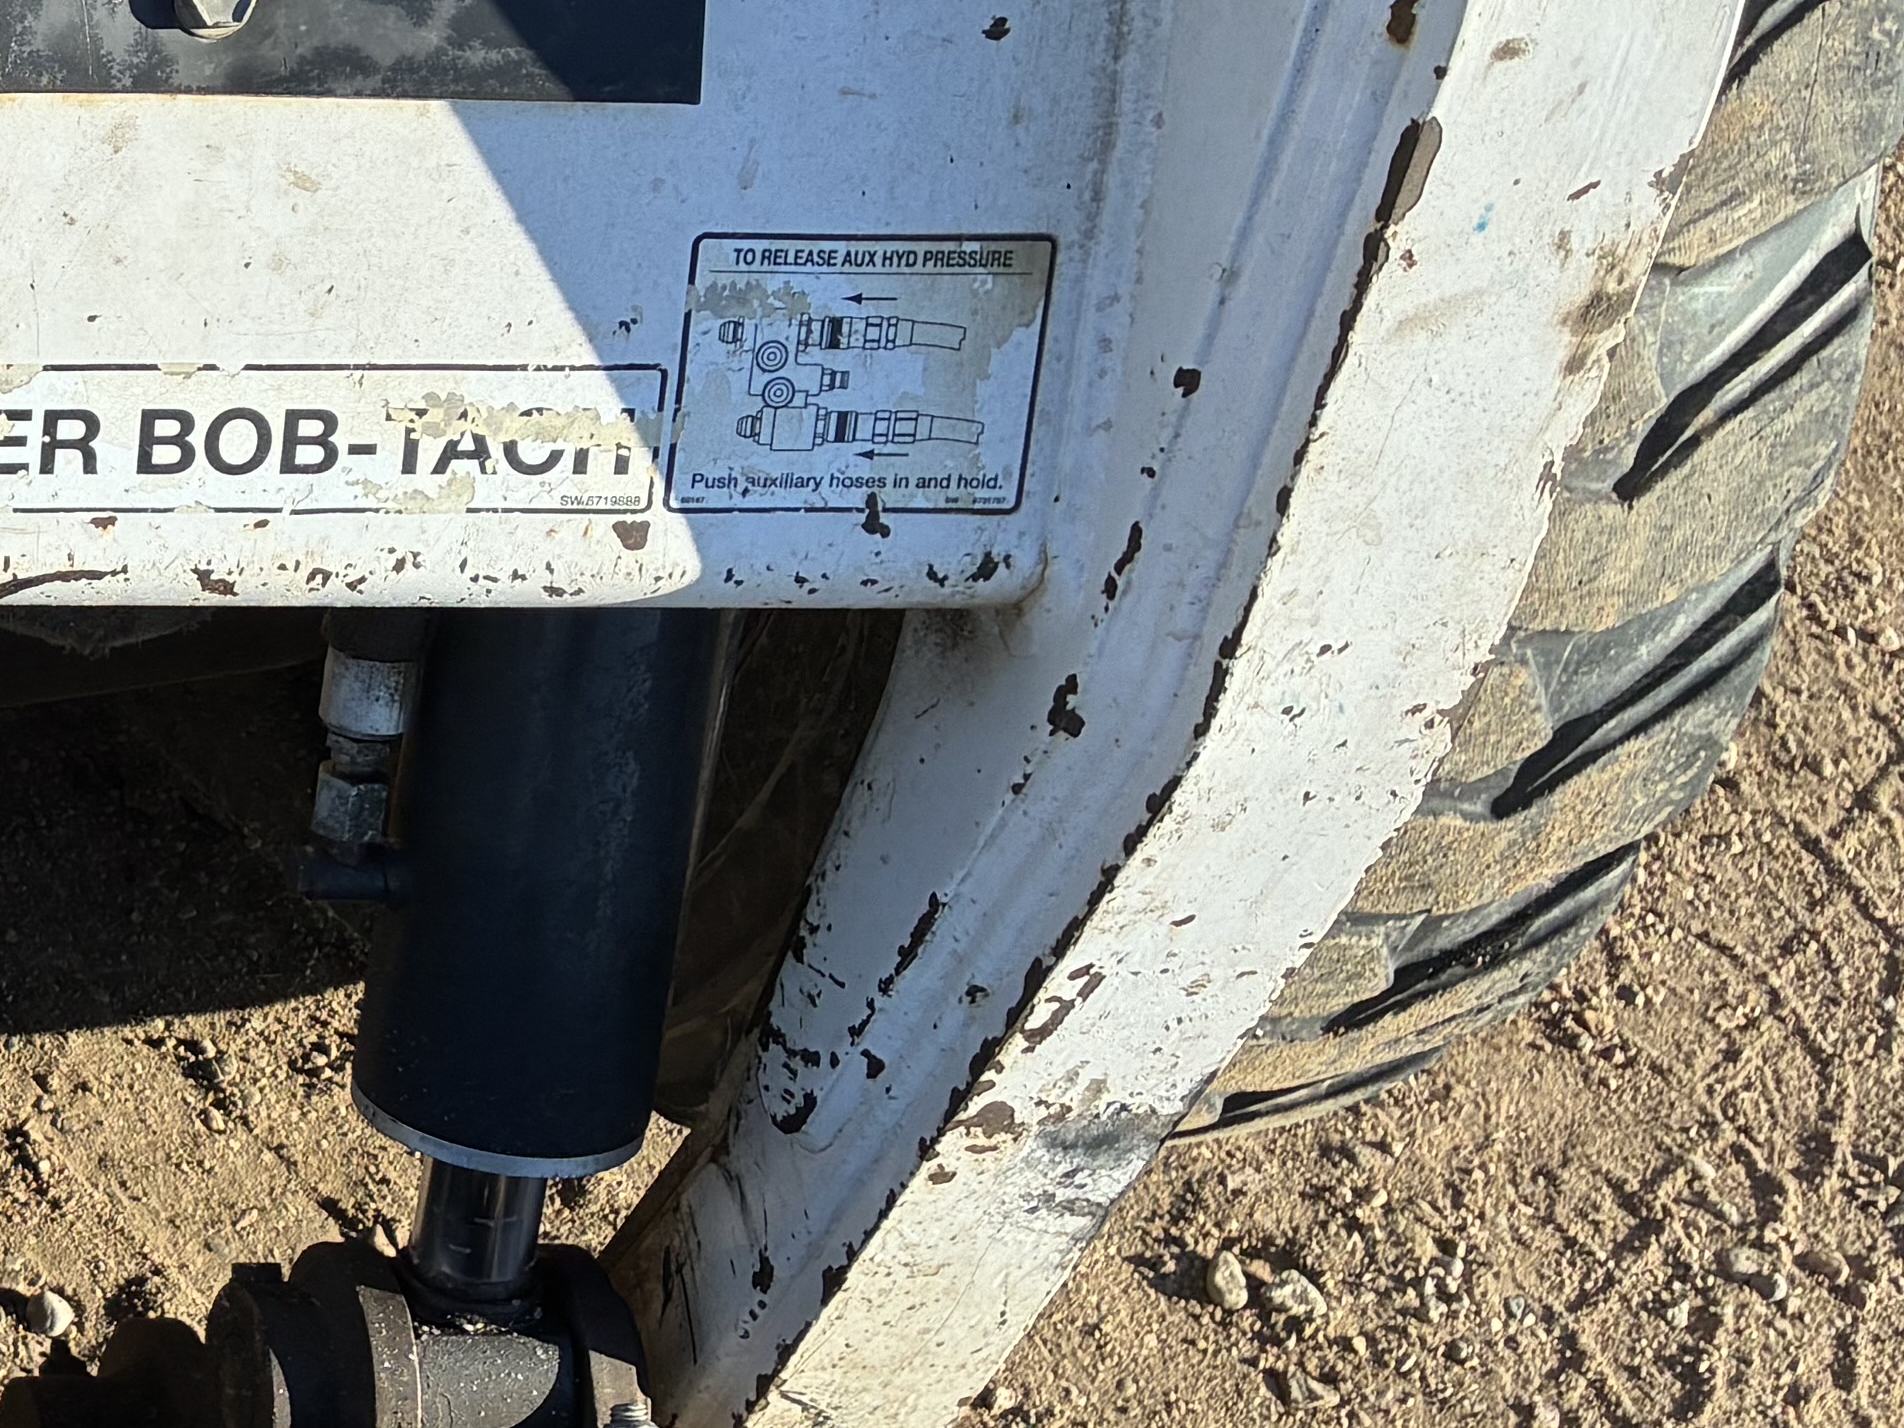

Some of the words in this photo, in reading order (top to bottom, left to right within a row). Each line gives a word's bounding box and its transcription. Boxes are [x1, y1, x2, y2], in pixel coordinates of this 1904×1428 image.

[733, 248, 756, 266] TO
[760, 248, 838, 267] RELEASE
[841, 249, 878, 268] AUX
[882, 249, 918, 268] HYD
[922, 249, 1014, 269] PRESSURE
[691, 473, 739, 490] Push
[745, 473, 825, 493] auxiliary
[828, 473, 887, 490] hoses
[893, 473, 910, 490] in
[915, 473, 951, 490] and
[956, 473, 1004, 491] hold.
